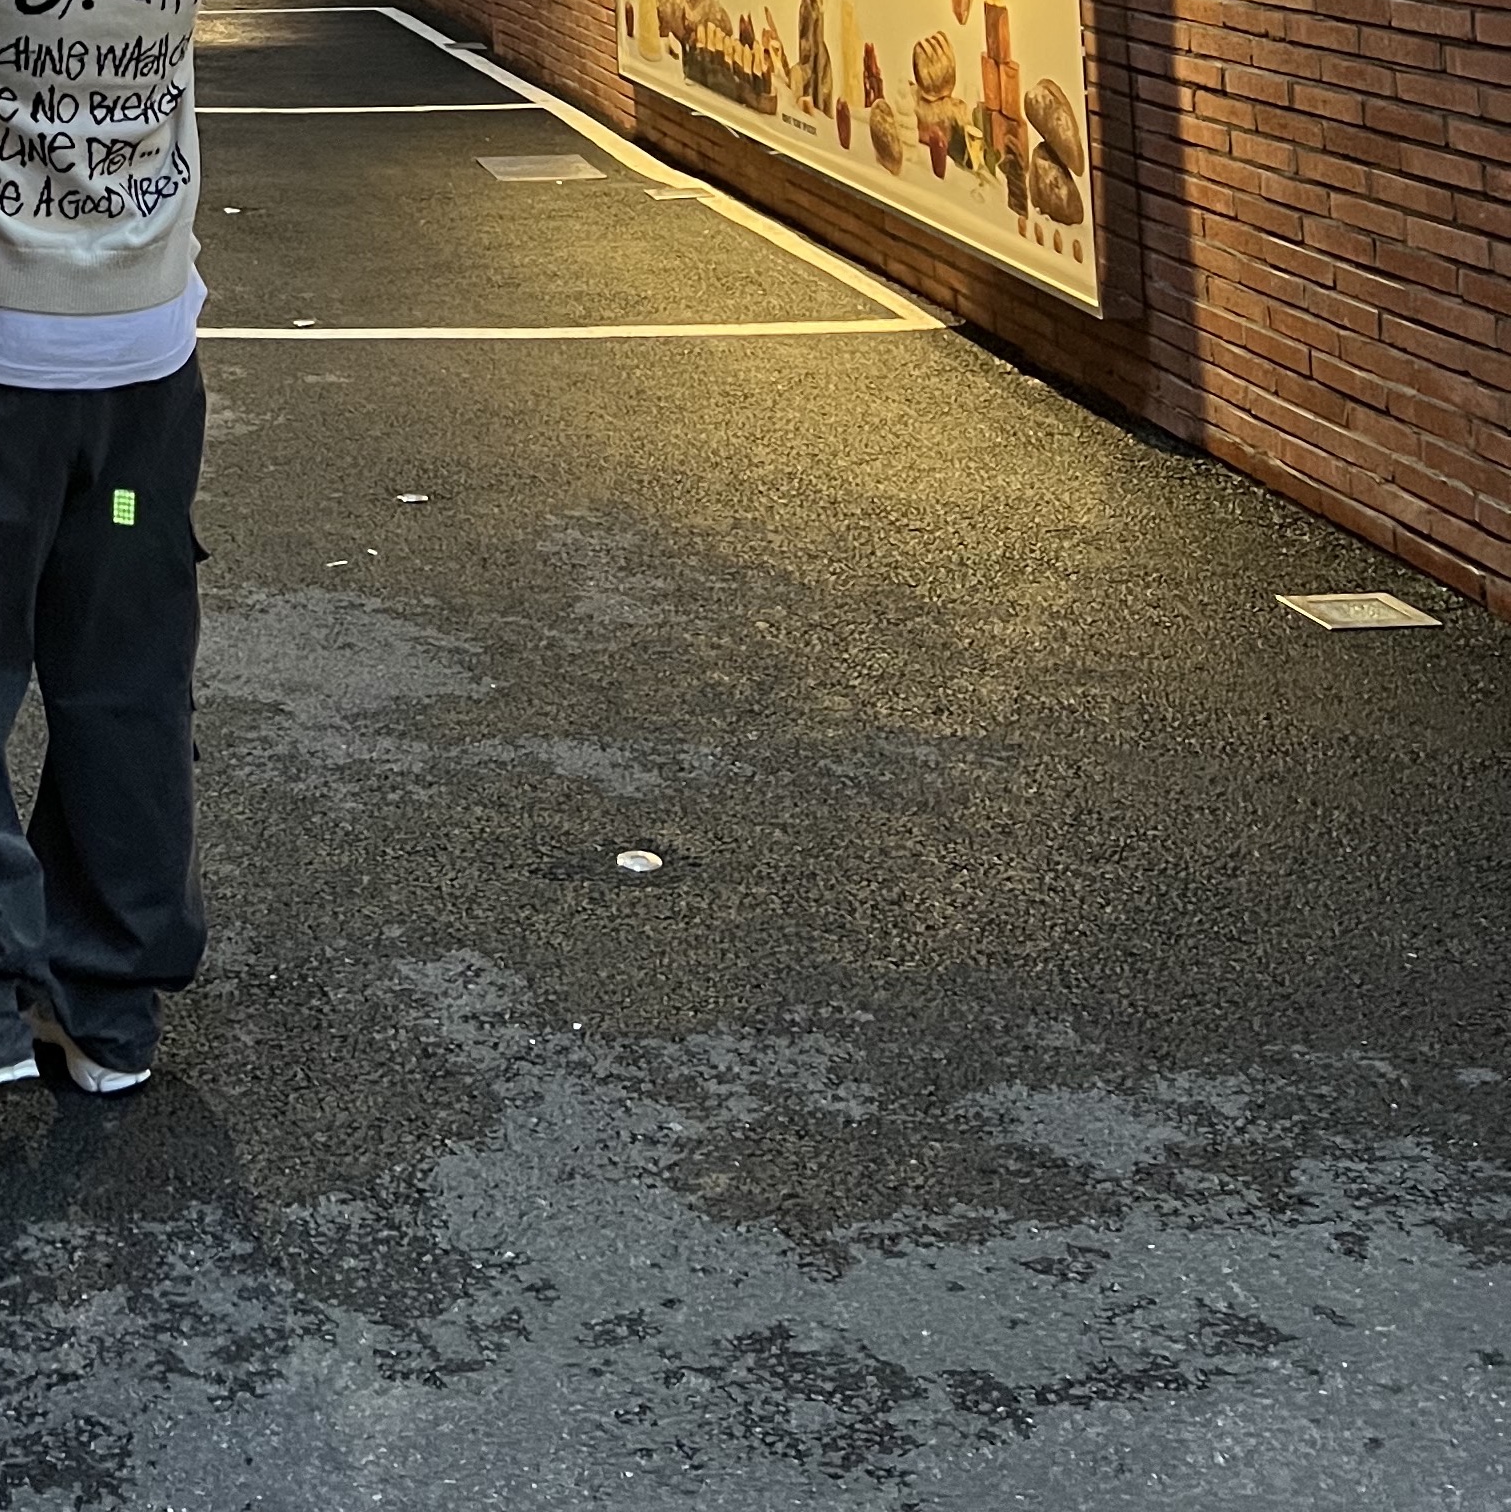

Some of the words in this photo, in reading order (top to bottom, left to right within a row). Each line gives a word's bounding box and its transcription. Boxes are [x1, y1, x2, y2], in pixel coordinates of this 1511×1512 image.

[30, 84, 79, 124] NO
[33, 175, 55, 218] A
[57, 185, 125, 219] GOOD
